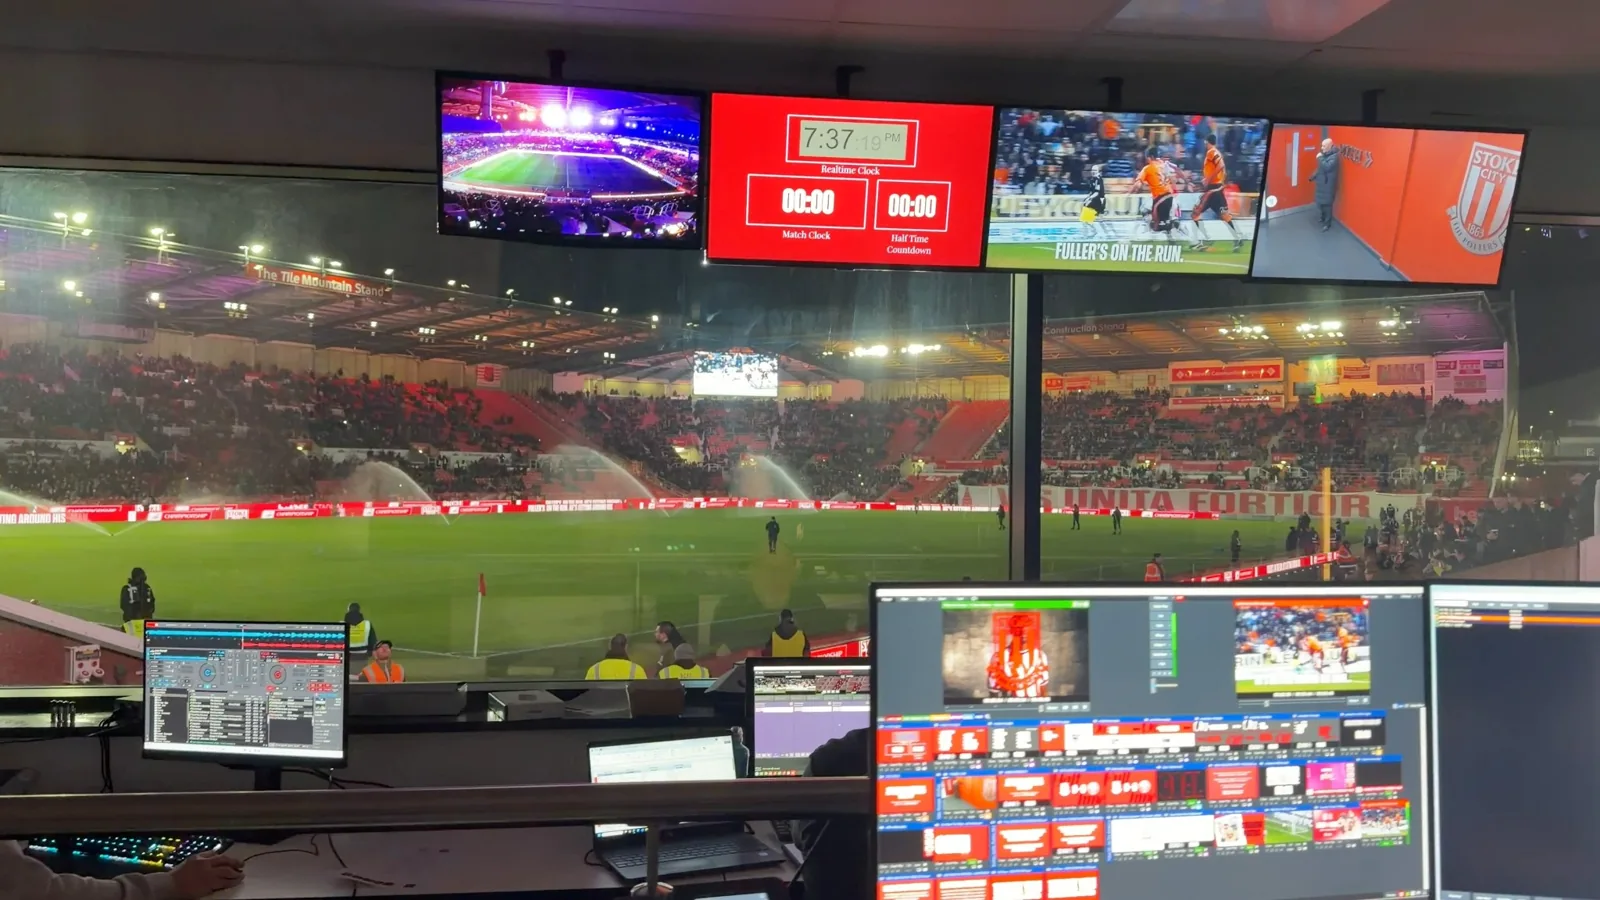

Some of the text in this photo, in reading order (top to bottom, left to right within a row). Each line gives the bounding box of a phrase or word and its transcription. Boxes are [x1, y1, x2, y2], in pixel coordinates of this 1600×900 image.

[884, 132, 901, 143] PM
[820, 164, 880, 176] Realtime Clock
[1480, 167, 1507, 184] CITY
[781, 187, 835, 215] 00:00
[888, 193, 937, 218] 00:00
[782, 229, 831, 240] Match Clock
[891, 233, 929, 244] Half Time
[886, 245, 931, 255] Countdown
[1055, 241, 1184, 263] FULLER'S ON THE RUN.
[256, 266, 384, 298] The Tile Mountain Stand
[1064, 488, 1175, 511] UNITA
[1188, 491, 1370, 518] FORTIOR
[18, 513, 51, 524] AROUND
[52, 512, 66, 524] HIS
